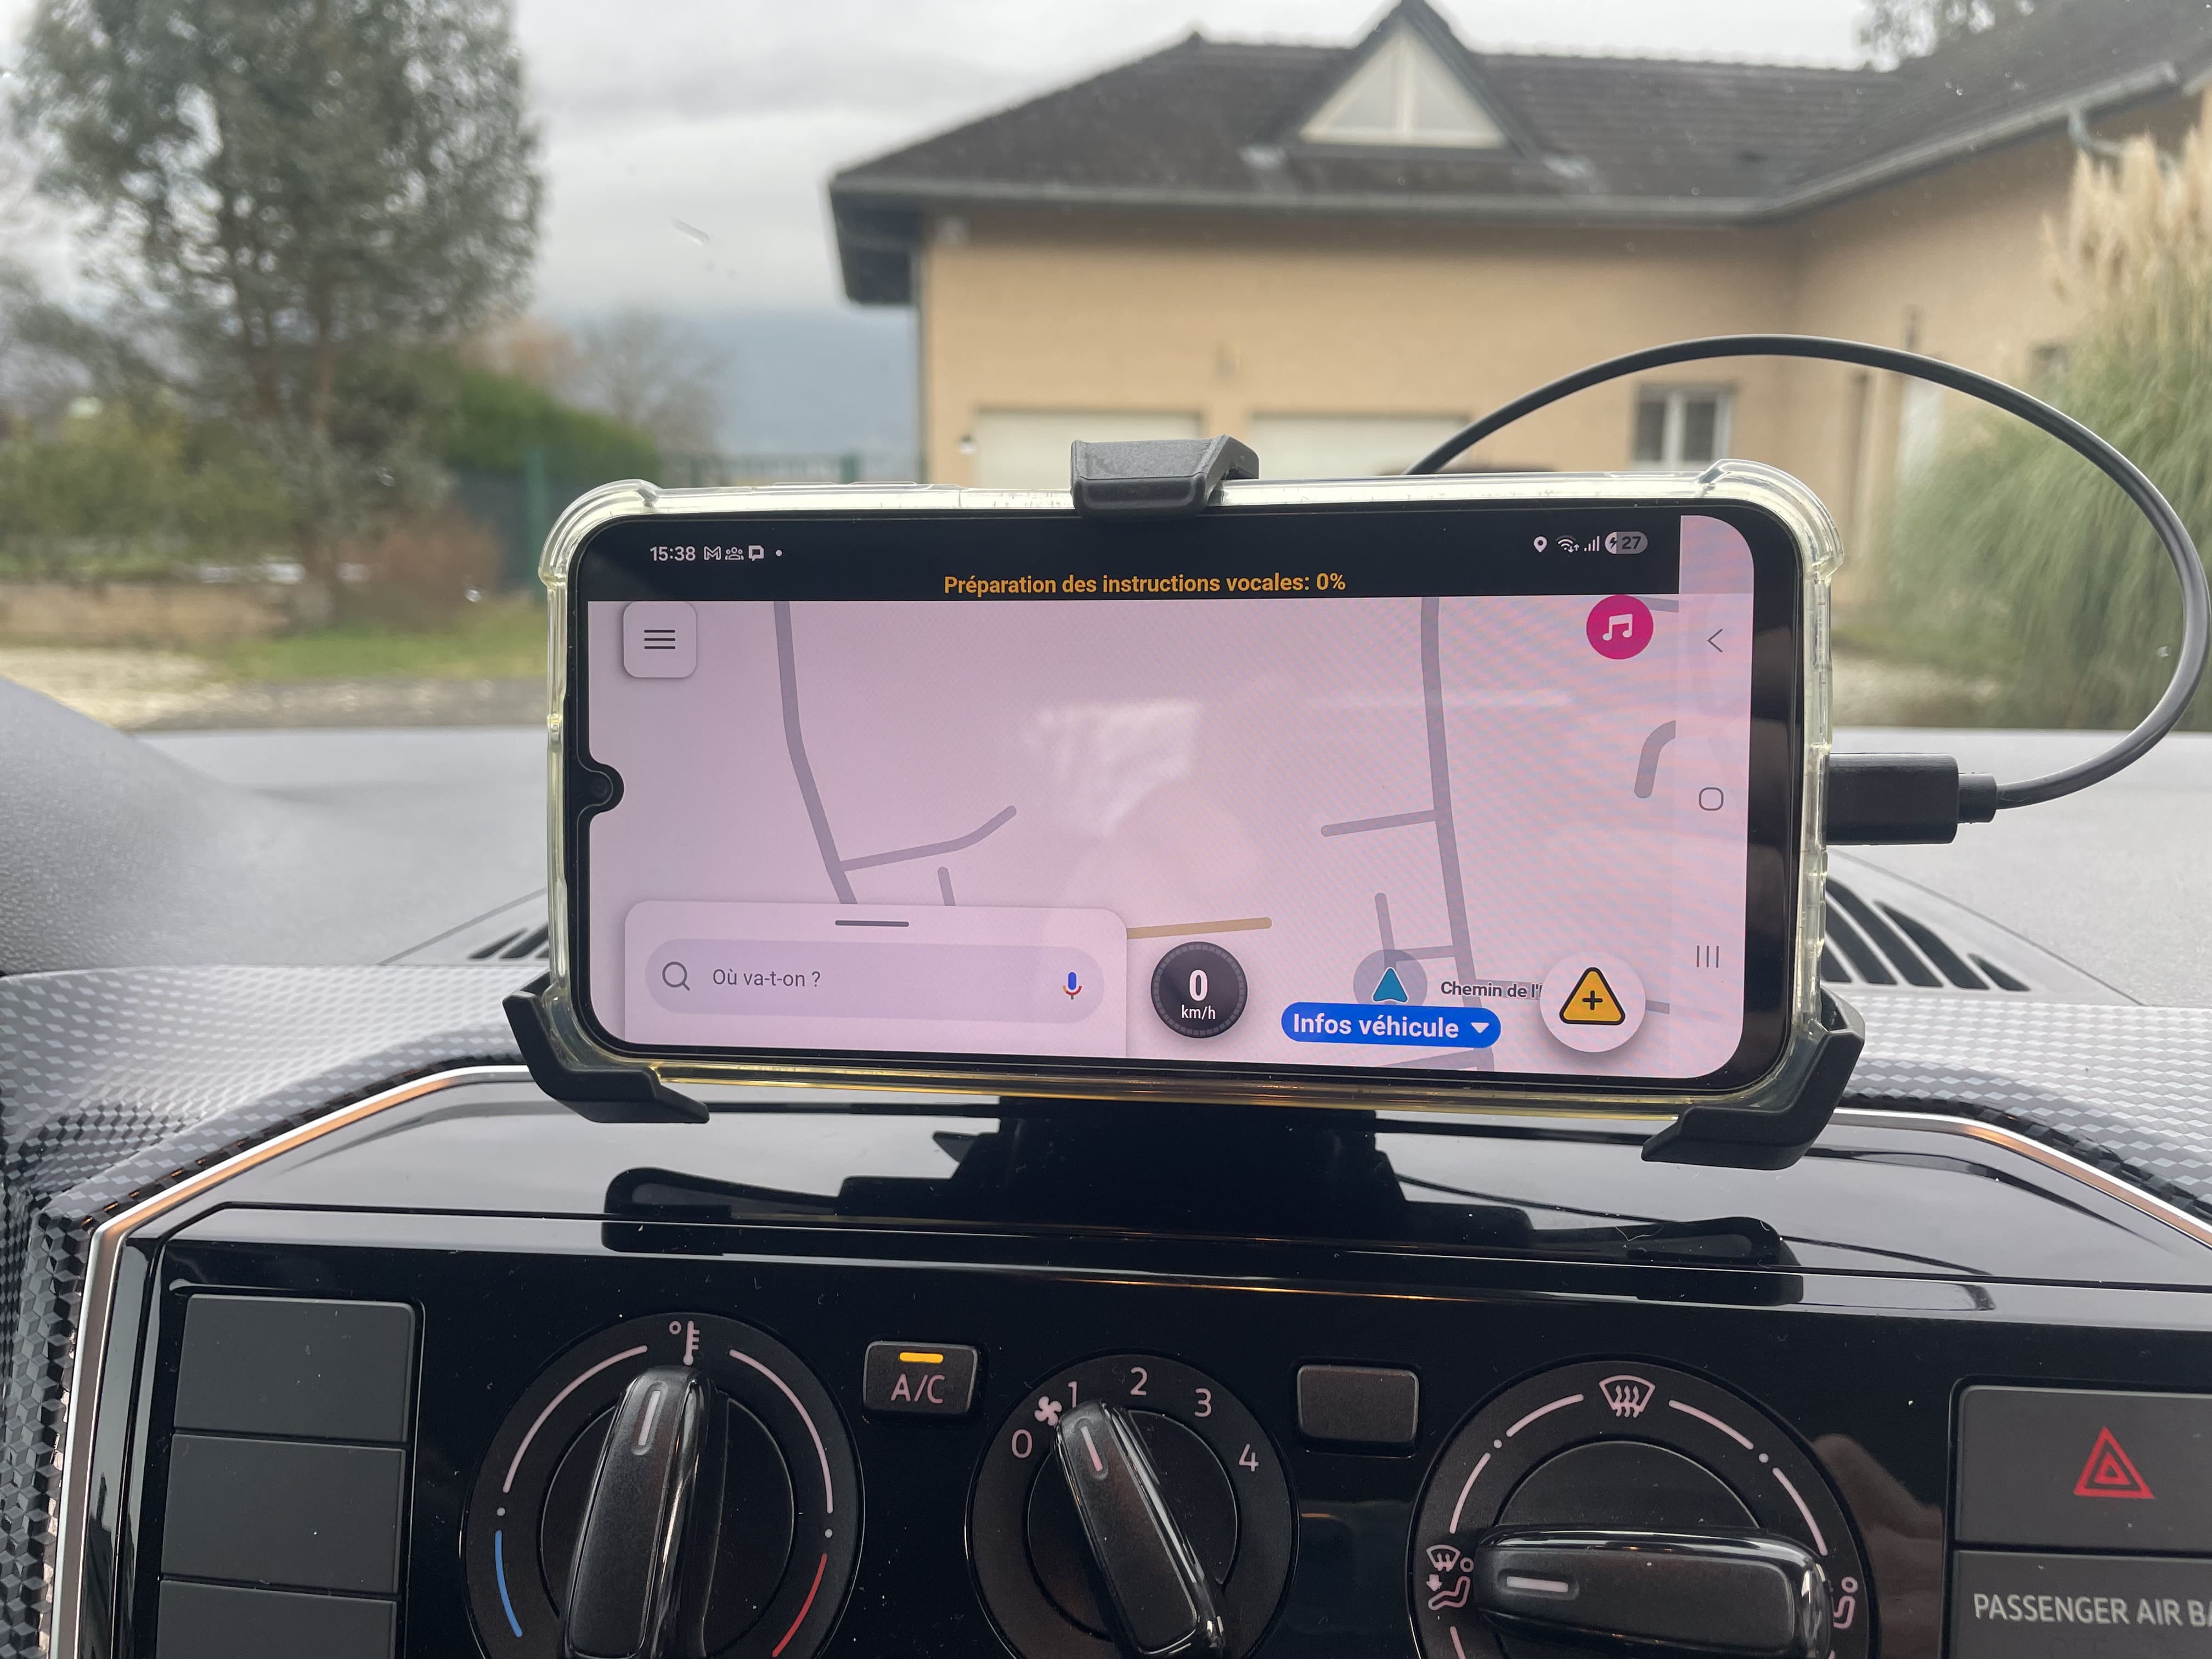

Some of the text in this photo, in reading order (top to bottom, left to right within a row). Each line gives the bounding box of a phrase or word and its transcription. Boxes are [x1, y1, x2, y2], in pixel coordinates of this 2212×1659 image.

[650, 545, 696, 562] 15:38
[1622, 536, 1641, 549] 27
[944, 572, 1346, 597] Préparation des instructions vocales: 0%
[713, 968, 821, 988] Où va-t-on ?
[1189, 969, 1209, 1001] 0
[1441, 981, 1501, 996] Chemin
[1506, 983, 1527, 997] de
[1181, 1004, 1216, 1021] km/h
[1294, 1013, 1459, 1039] Infos véhicule
[891, 1374, 946, 1403] A/C
[1068, 1381, 1079, 1408] 1
[1130, 1367, 1148, 1396] 2
[1195, 1388, 1211, 1417] 3
[1012, 1429, 1032, 1459] 0
[1239, 1444, 1259, 1472] 4
[1974, 1593, 2212, 1628] PASSENGER AIR B
